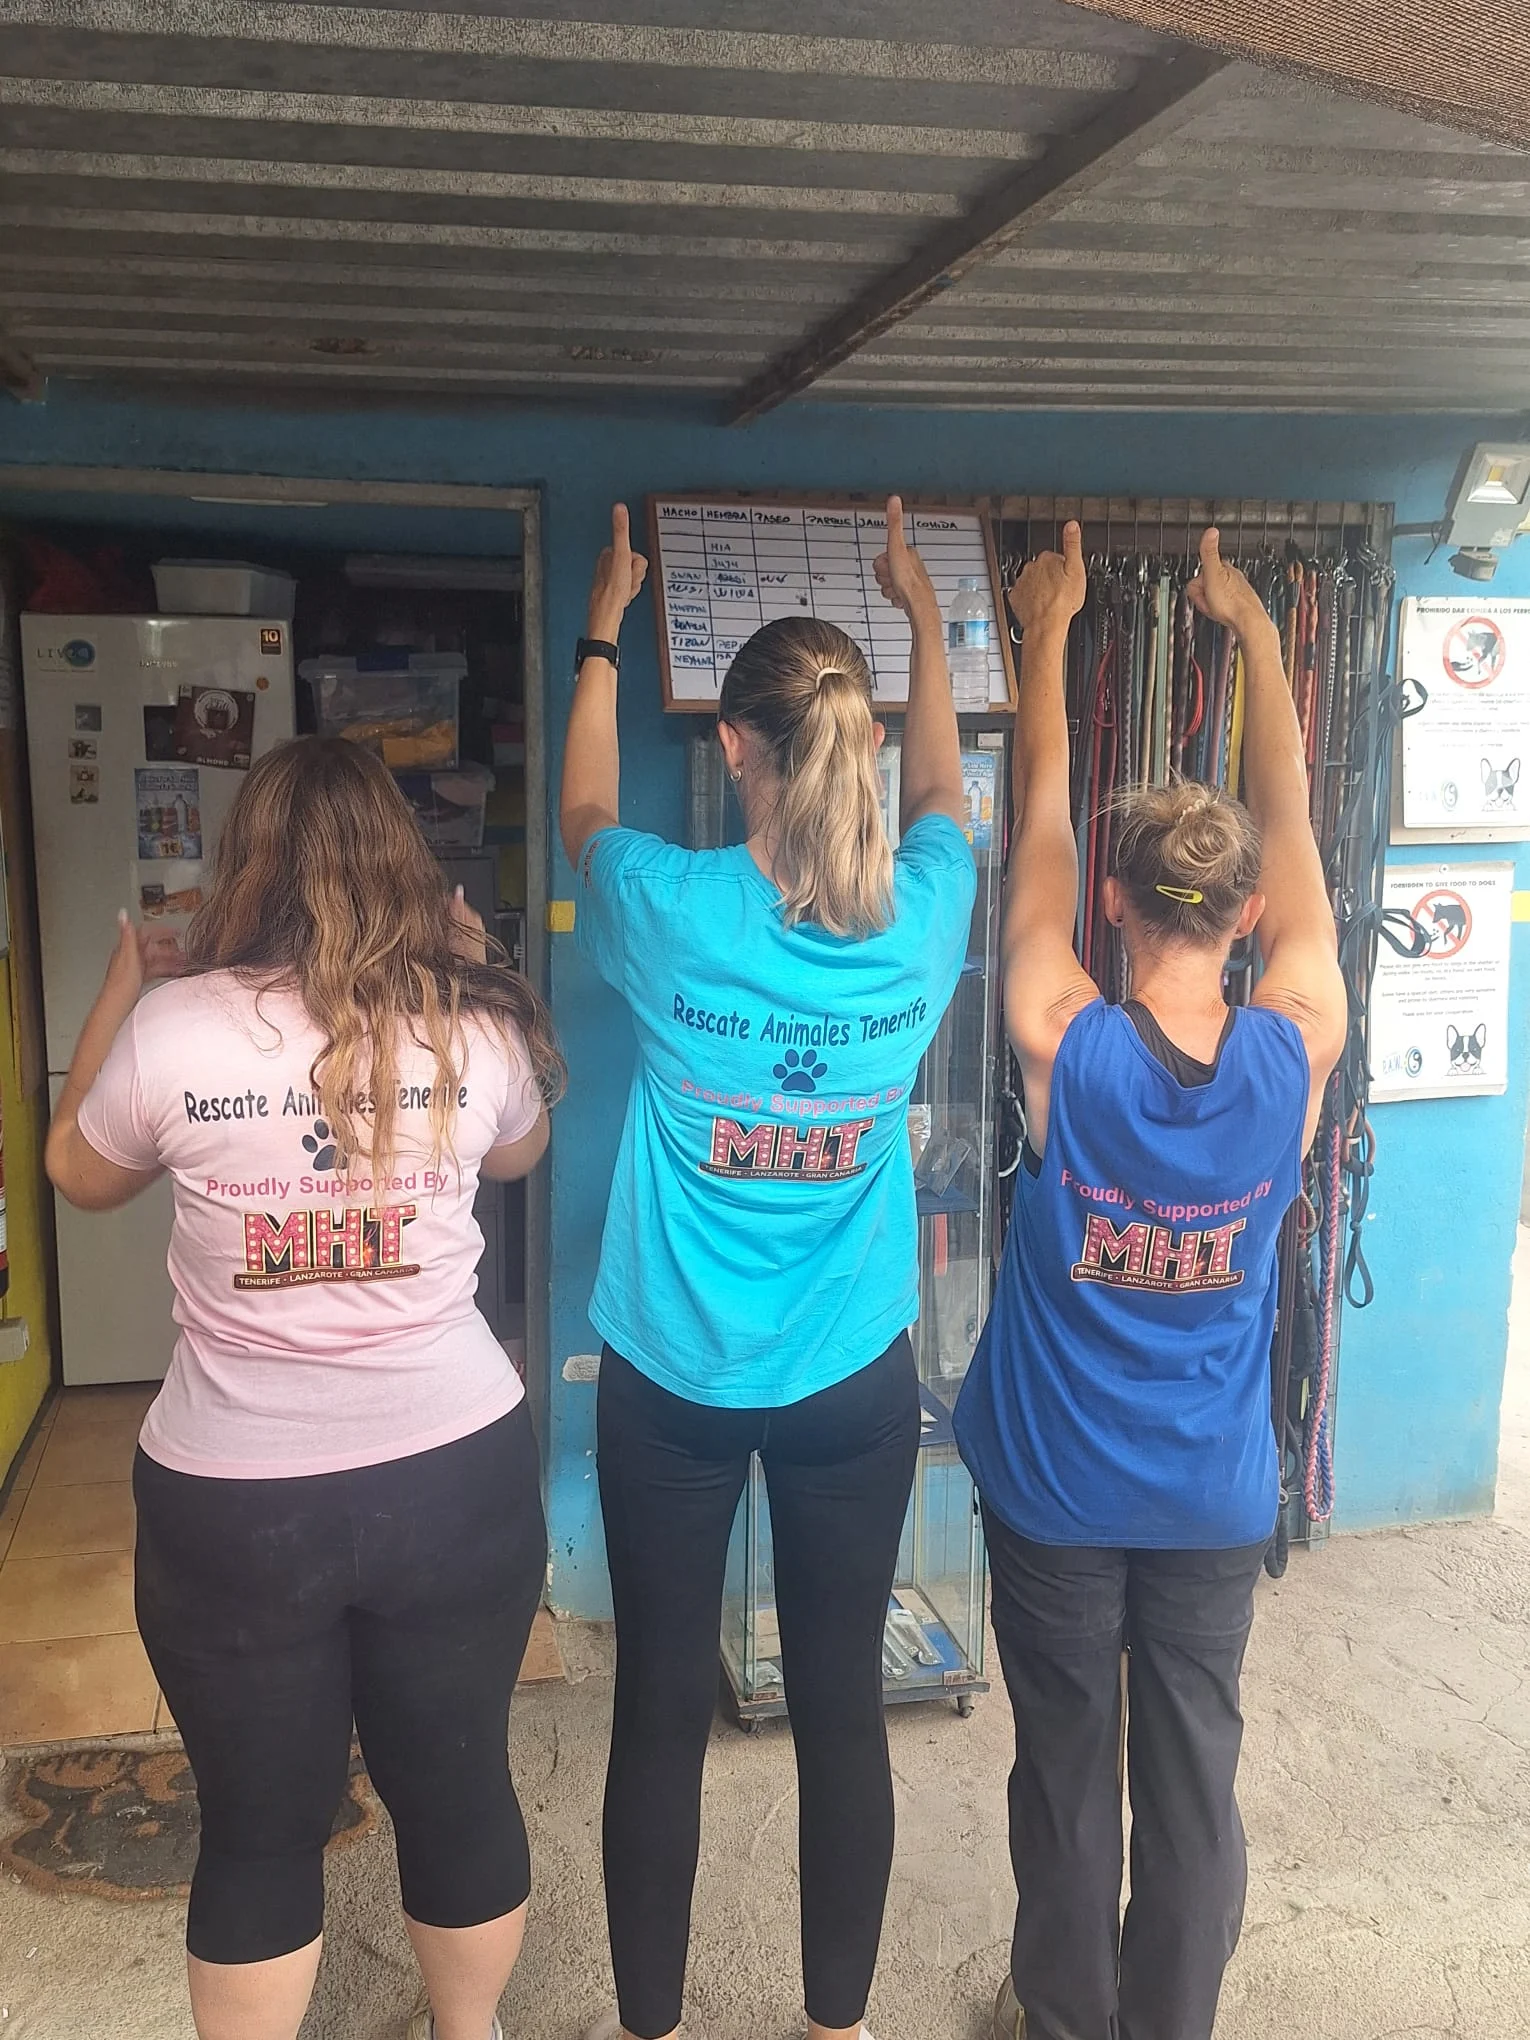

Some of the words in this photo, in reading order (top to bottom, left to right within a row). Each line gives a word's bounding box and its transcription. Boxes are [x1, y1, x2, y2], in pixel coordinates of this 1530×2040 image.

[754, 511, 791, 524] PASEO
[261, 630, 279, 642] 10
[1390, 881, 1424, 889] FORBIDDEN
[673, 993, 750, 1040] Rescate
[759, 1012, 850, 1047] Animales
[859, 996, 927, 1043] Tenerife
[184, 1089, 269, 1124] Rescate
[681, 1079, 763, 1113] Proudly
[770, 1092, 880, 1118] Supported
[710, 1116, 876, 1169] MHT
[205, 1177, 291, 1200] Proudly
[423, 1170, 449, 1192] By
[703, 1165, 743, 1177] TENERIFE
[750, 1170, 800, 1178] LANZAROTE
[1142, 1191, 1252, 1222] Supported
[243, 1204, 419, 1273] MHT
[1081, 1212, 1248, 1281] MHT
[238, 1276, 281, 1286] TENERIFE
[289, 1271, 343, 1282] LANZAROTE
[350, 1270, 373, 1278] GRAN
[1076, 1266, 1113, 1282] TENERIFE
[1121, 1275, 1173, 1288] LANZAROTE
[1179, 1280, 1201, 1289] GRAN
[1202, 1274, 1239, 1286] CANARIA
